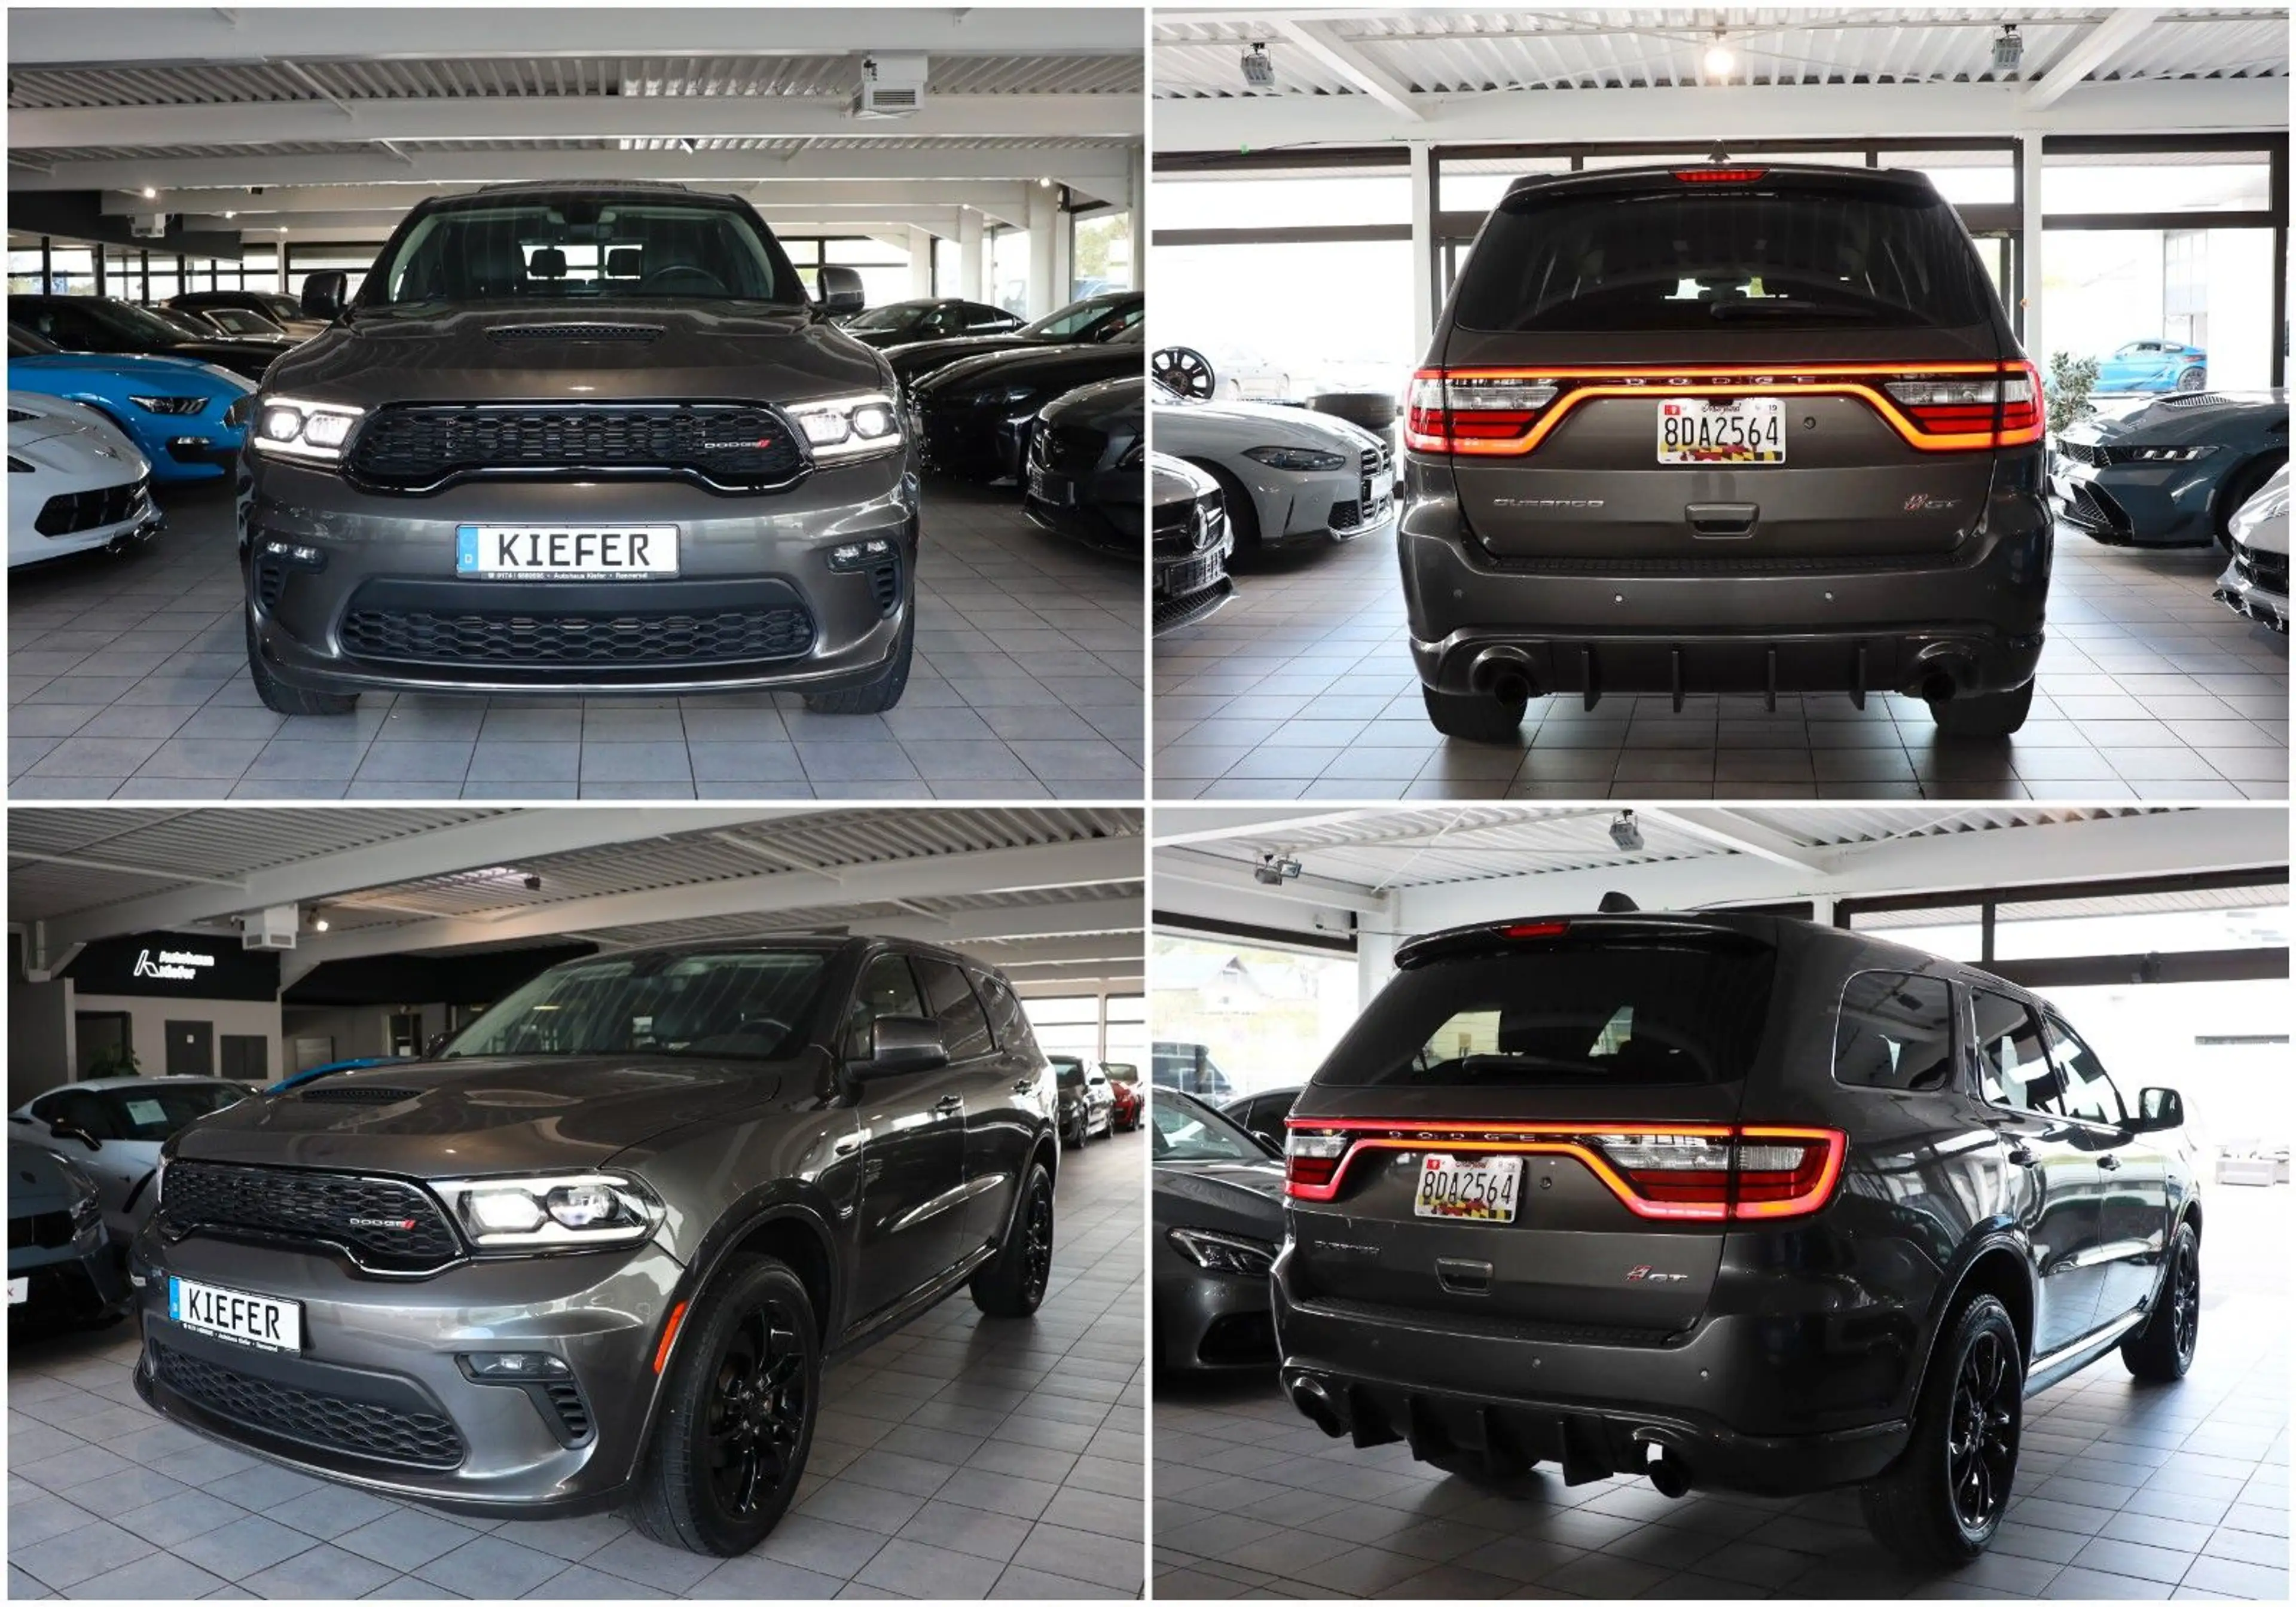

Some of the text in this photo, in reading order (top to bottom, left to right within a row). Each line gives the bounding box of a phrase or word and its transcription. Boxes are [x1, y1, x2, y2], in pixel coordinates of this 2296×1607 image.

[1664, 416, 1778, 446] 8DA2564
[499, 533, 651, 566] KIEFER
[1422, 1171, 1514, 1205] 8DA2564
[349, 1218, 405, 1229] DODGE
[189, 1287, 280, 1340] KIEFER
